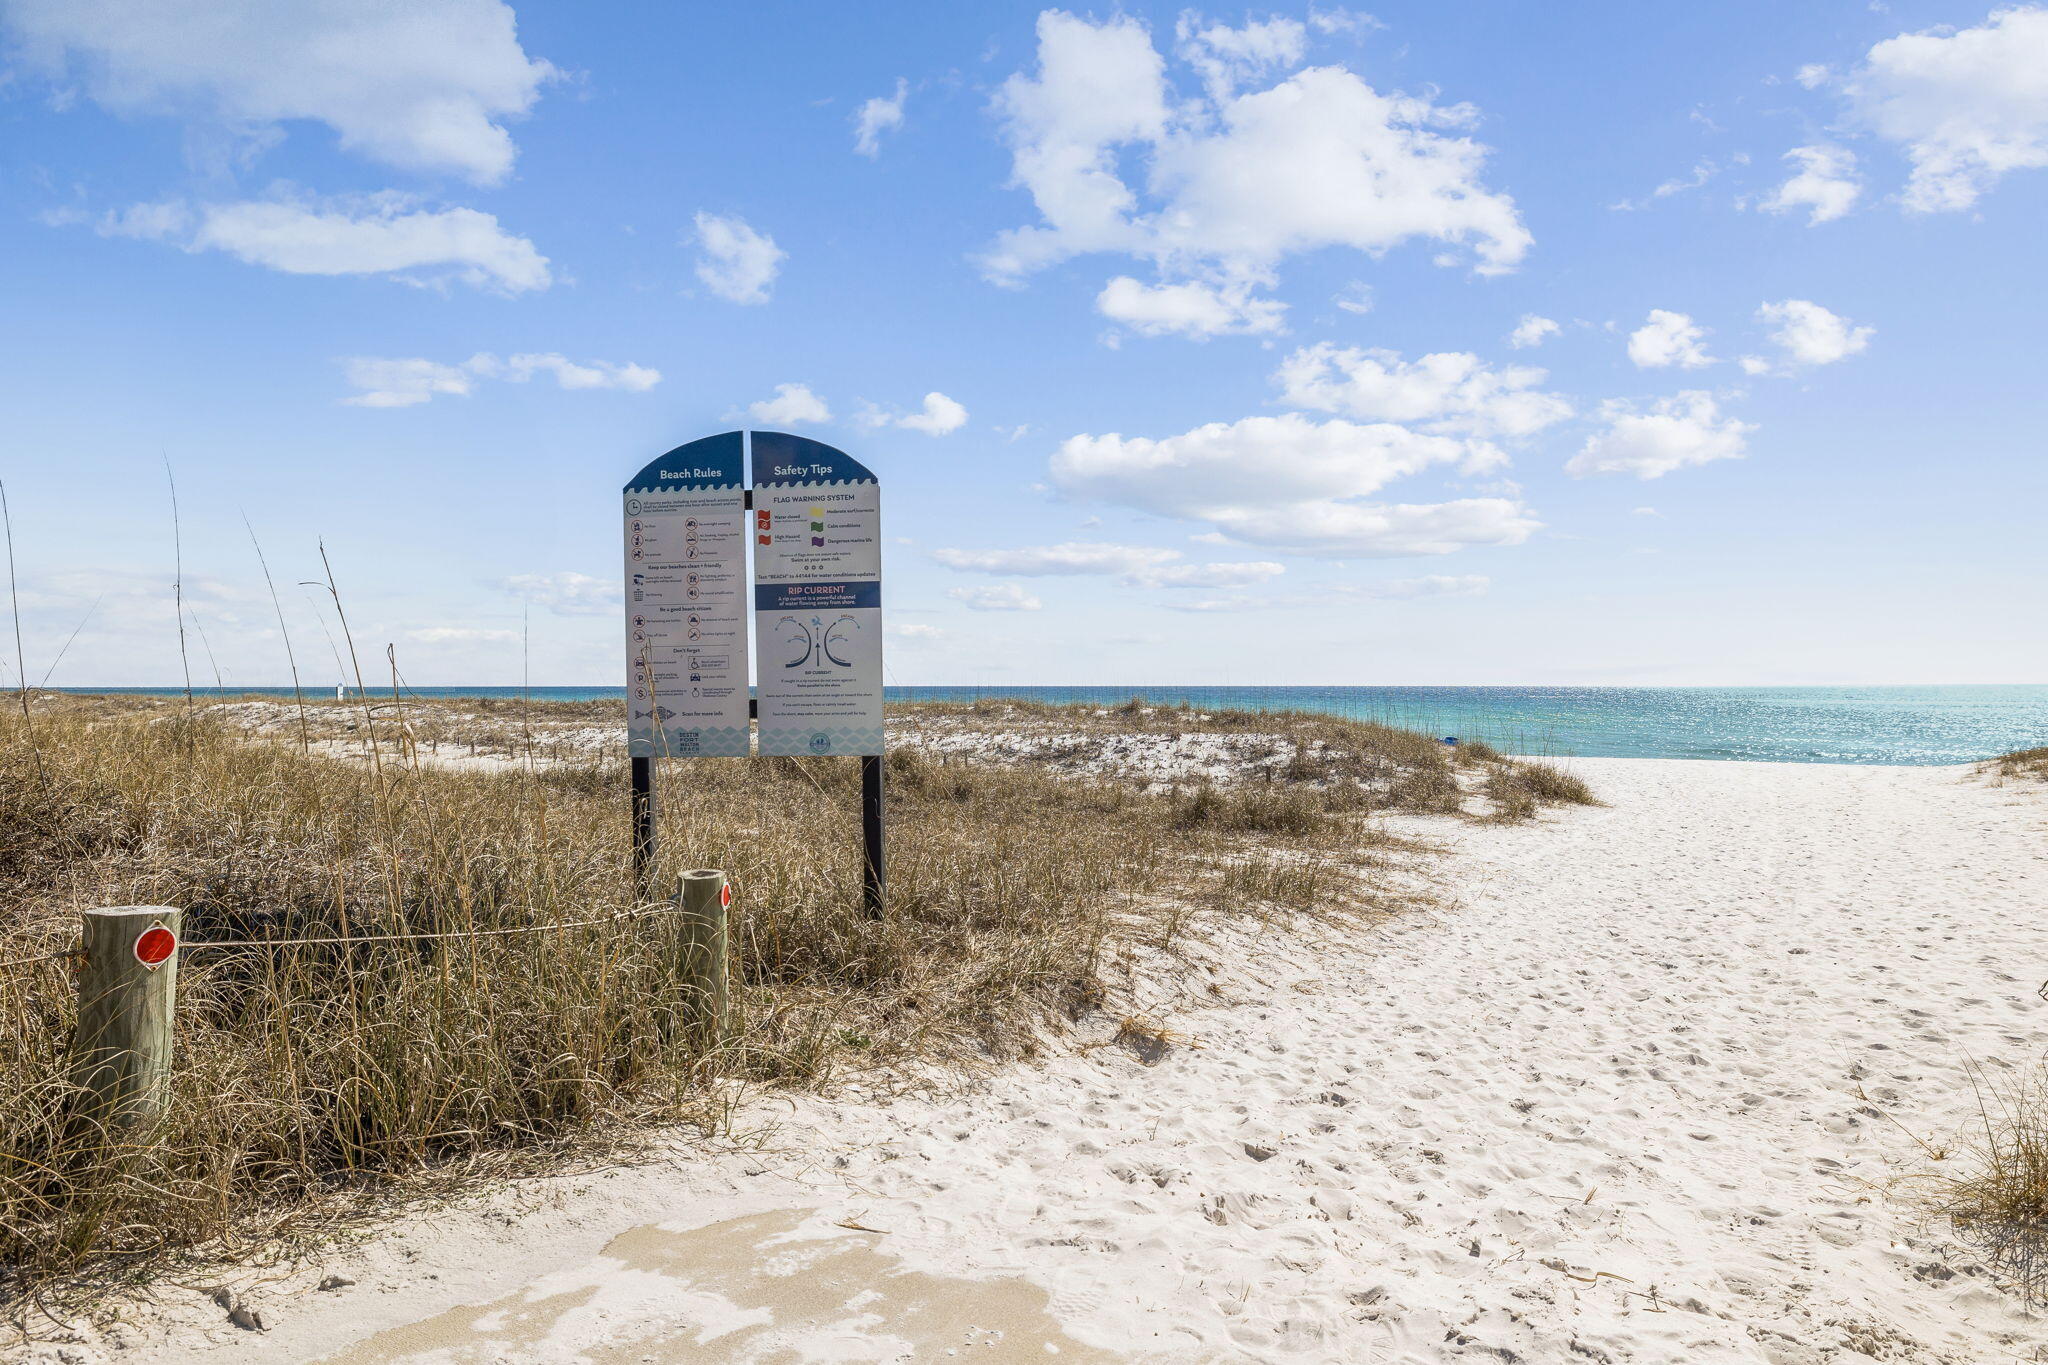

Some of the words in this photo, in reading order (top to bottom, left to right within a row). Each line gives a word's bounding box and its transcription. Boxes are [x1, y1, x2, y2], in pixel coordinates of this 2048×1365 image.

[660, 468, 691, 479] Beach
[694, 468, 722, 478] Rules
[774, 465, 808, 476] Safety
[810, 464, 832, 476] Tips
[804, 586, 846, 594] CURRENT
